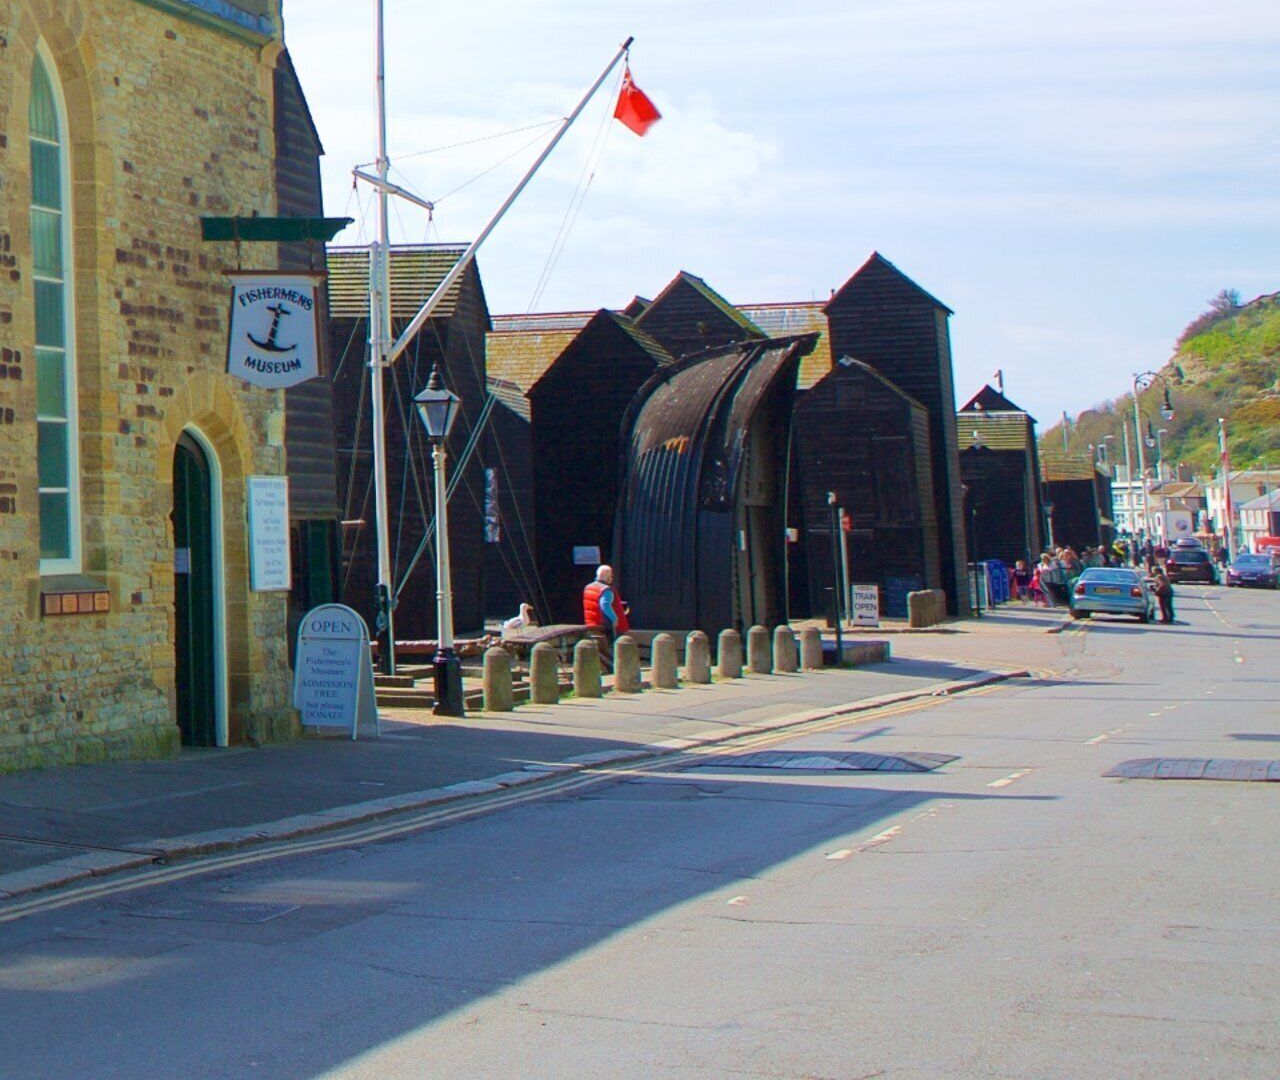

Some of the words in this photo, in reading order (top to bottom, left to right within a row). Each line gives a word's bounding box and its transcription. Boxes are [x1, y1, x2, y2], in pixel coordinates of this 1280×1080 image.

[238, 287, 313, 311] FISHERMENS
[244, 357, 301, 374] MUSEUM
[854, 592, 877, 601] TRAIN
[854, 603, 877, 611] OPEN
[311, 620, 352, 633] OPEN
[301, 680, 353, 688] ADMISSION
[313, 690, 338, 698] FREE
